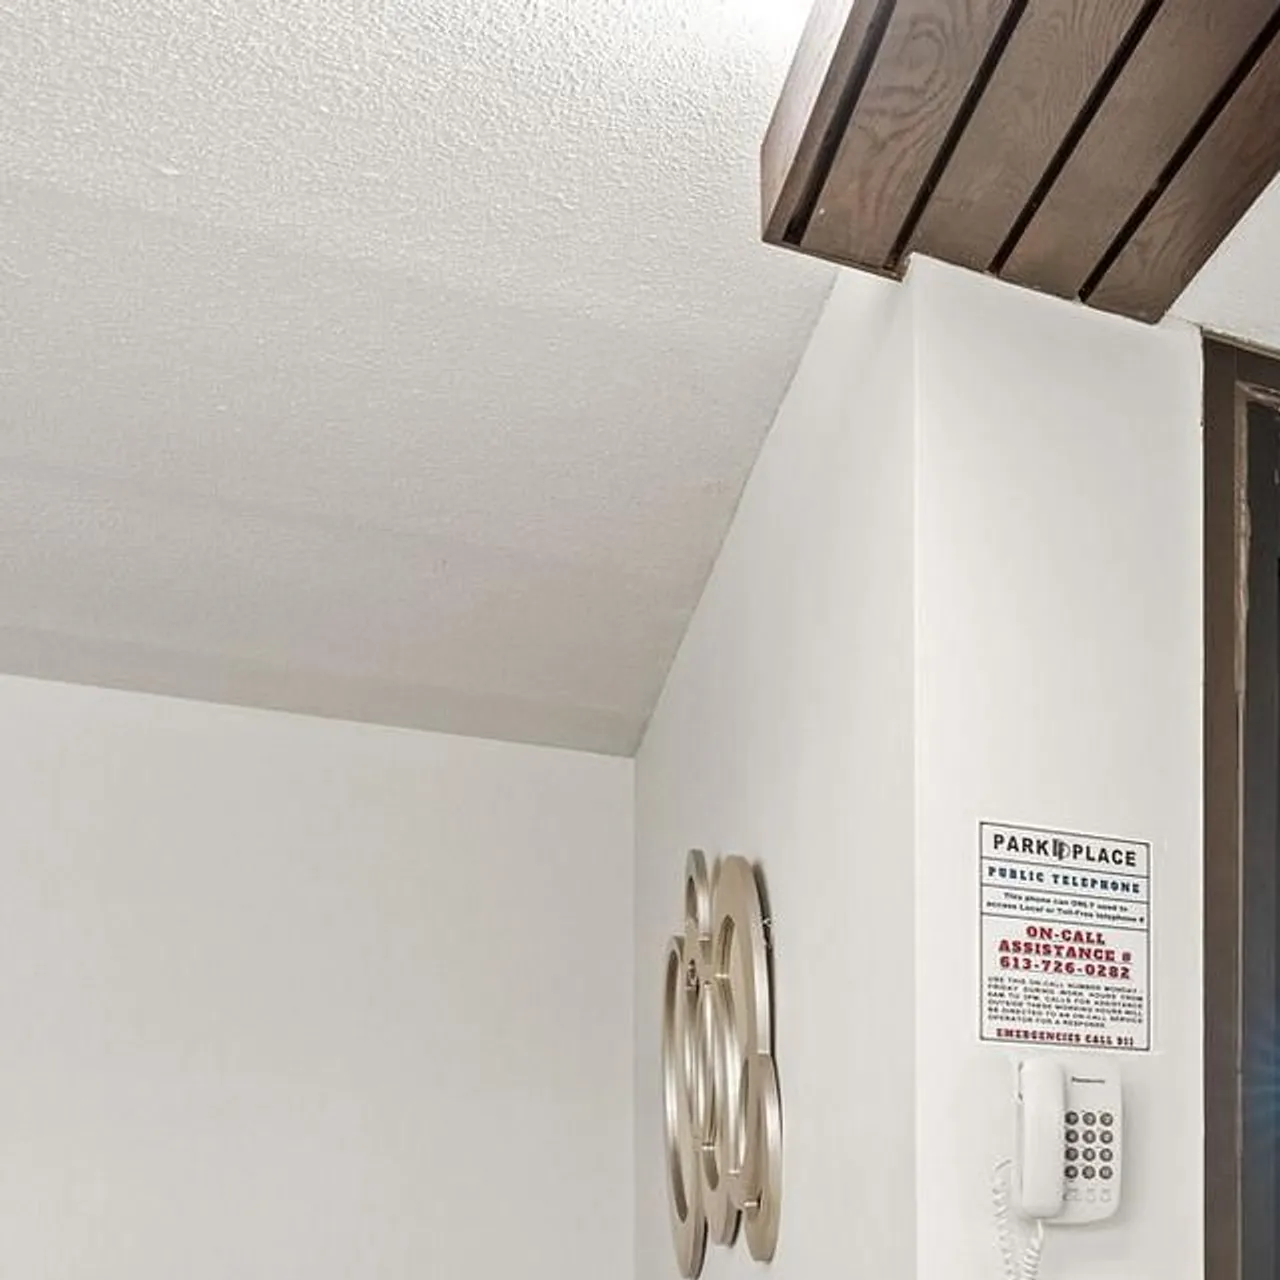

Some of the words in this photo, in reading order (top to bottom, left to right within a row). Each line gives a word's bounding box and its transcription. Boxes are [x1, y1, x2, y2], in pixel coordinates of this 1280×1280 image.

[993, 833, 1049, 857] PARK
[1072, 844, 1137, 867] PLACE
[988, 866, 1045, 882] PUBLIC
[1052, 874, 1140, 894] TELEPHONE
[1024, 894, 1051, 904] phone
[1053, 898, 1069, 906] can
[1070, 900, 1095, 909] ONLY
[1026, 925, 1106, 945] ON-CALL
[999, 939, 1116, 962] ASSISTANCE
[999, 956, 1131, 979] 613-726-0282
[996, 1028, 1081, 1043] EMERGENCIES
[1085, 1035, 1113, 1045] CALL
[1117, 1037, 1134, 1046] 911
